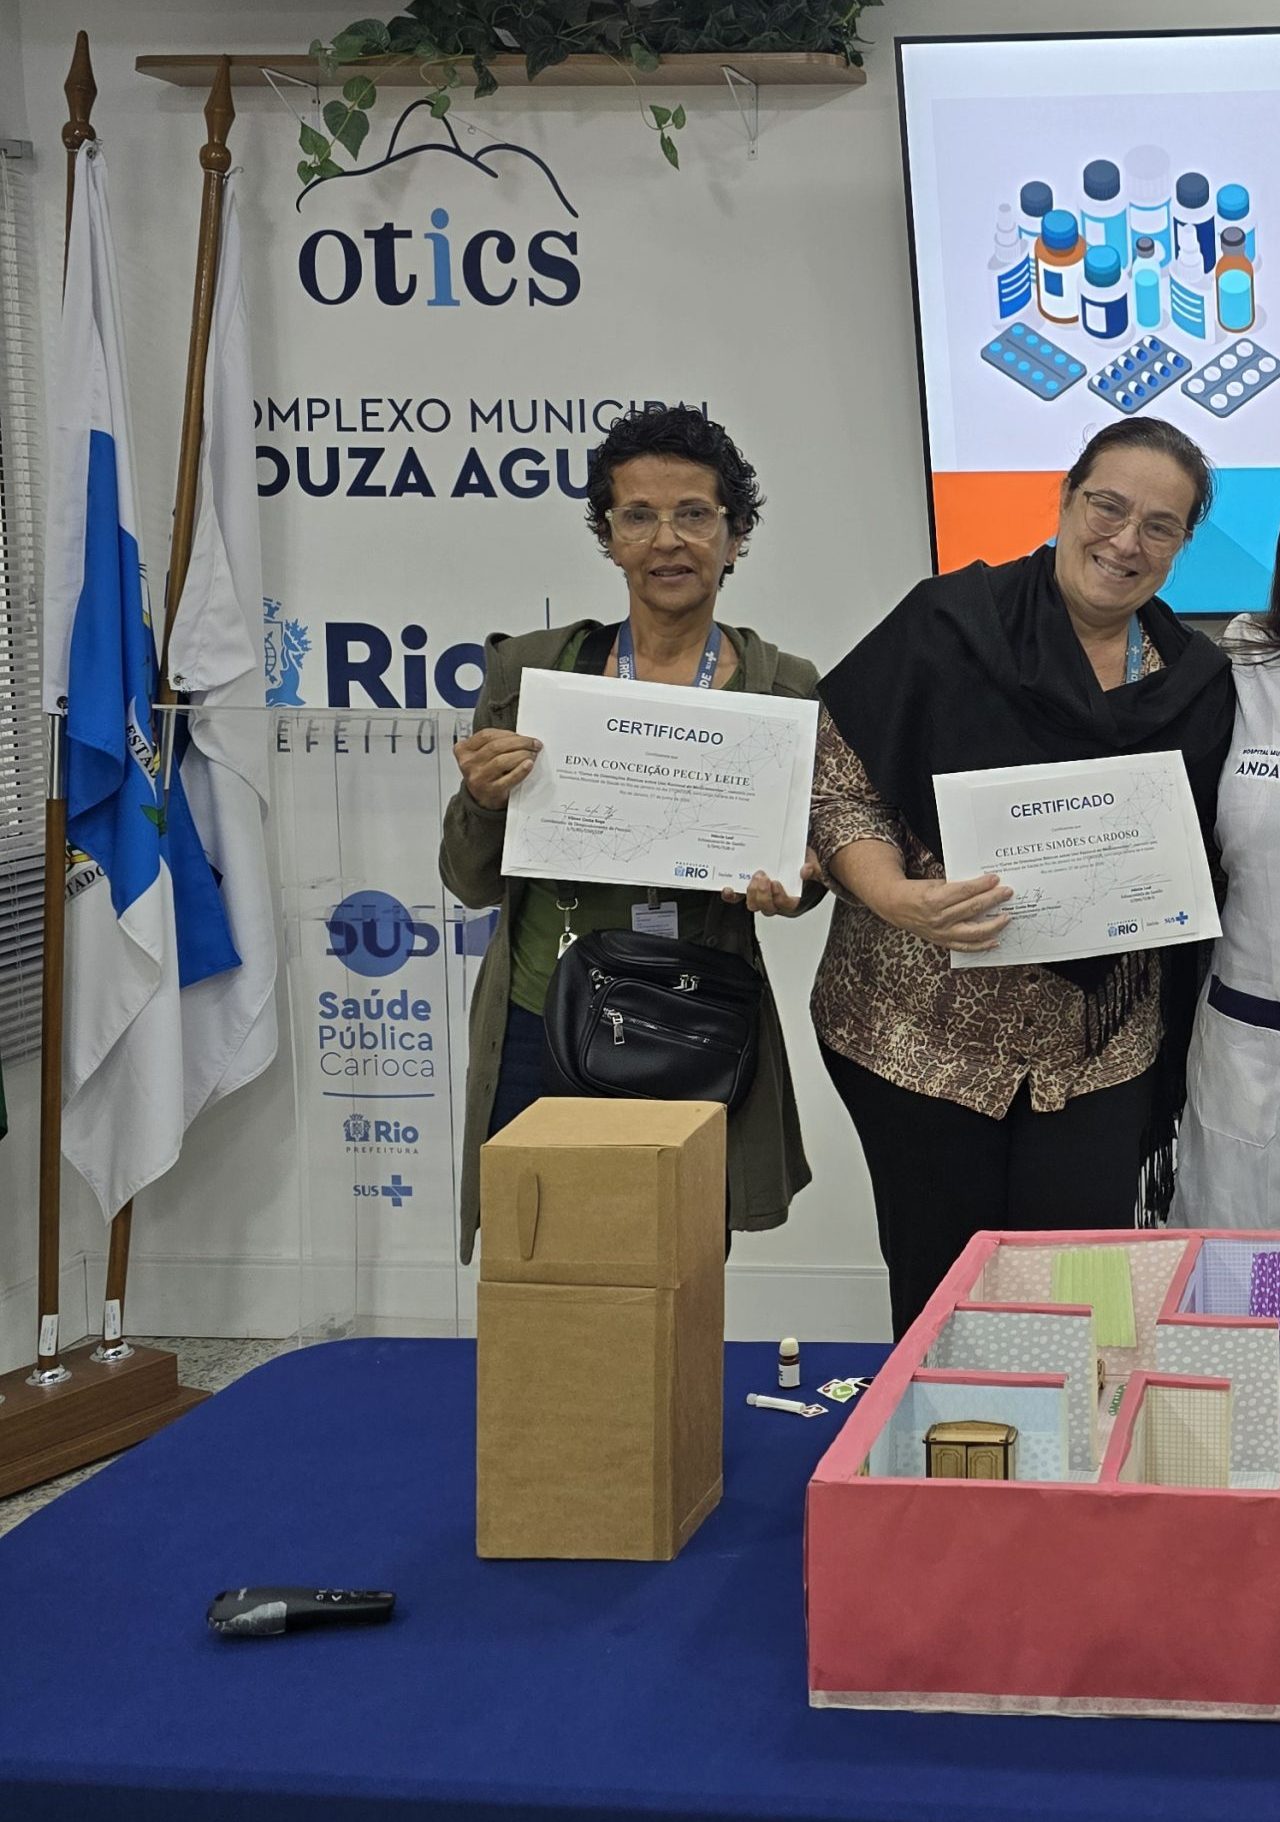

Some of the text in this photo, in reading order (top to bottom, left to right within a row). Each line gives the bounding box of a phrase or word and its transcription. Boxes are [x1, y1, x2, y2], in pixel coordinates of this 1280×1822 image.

[298, 207, 581, 308] otics
[254, 396, 452, 433] MPLEXO
[325, 622, 487, 709] Rio
[607, 718, 724, 745] CERTIFICADO
[1242, 748, 1269, 756] HOSPITAL
[565, 754, 597, 768] EDNA
[601, 758, 671, 778] CONCEIÇÃO
[673, 768, 713, 784] PECLY
[715, 775, 752, 787] LEITE
[1011, 793, 1115, 818] CERTIFICADO
[995, 843, 1044, 858] CELESTE
[1046, 835, 1086, 851] SIMÕES
[1088, 828, 1140, 844] CARDOSO
[685, 866, 709, 879] RIO
[1117, 922, 1138, 936] RIO
[318, 989, 432, 1021] Saúde
[319, 1023, 433, 1052] Pública
[320, 1052, 435, 1078] Carioca
[374, 1119, 419, 1144] Rio
[346, 1146, 419, 1154] PREFEITURA
[353, 1184, 379, 1197] SUS
